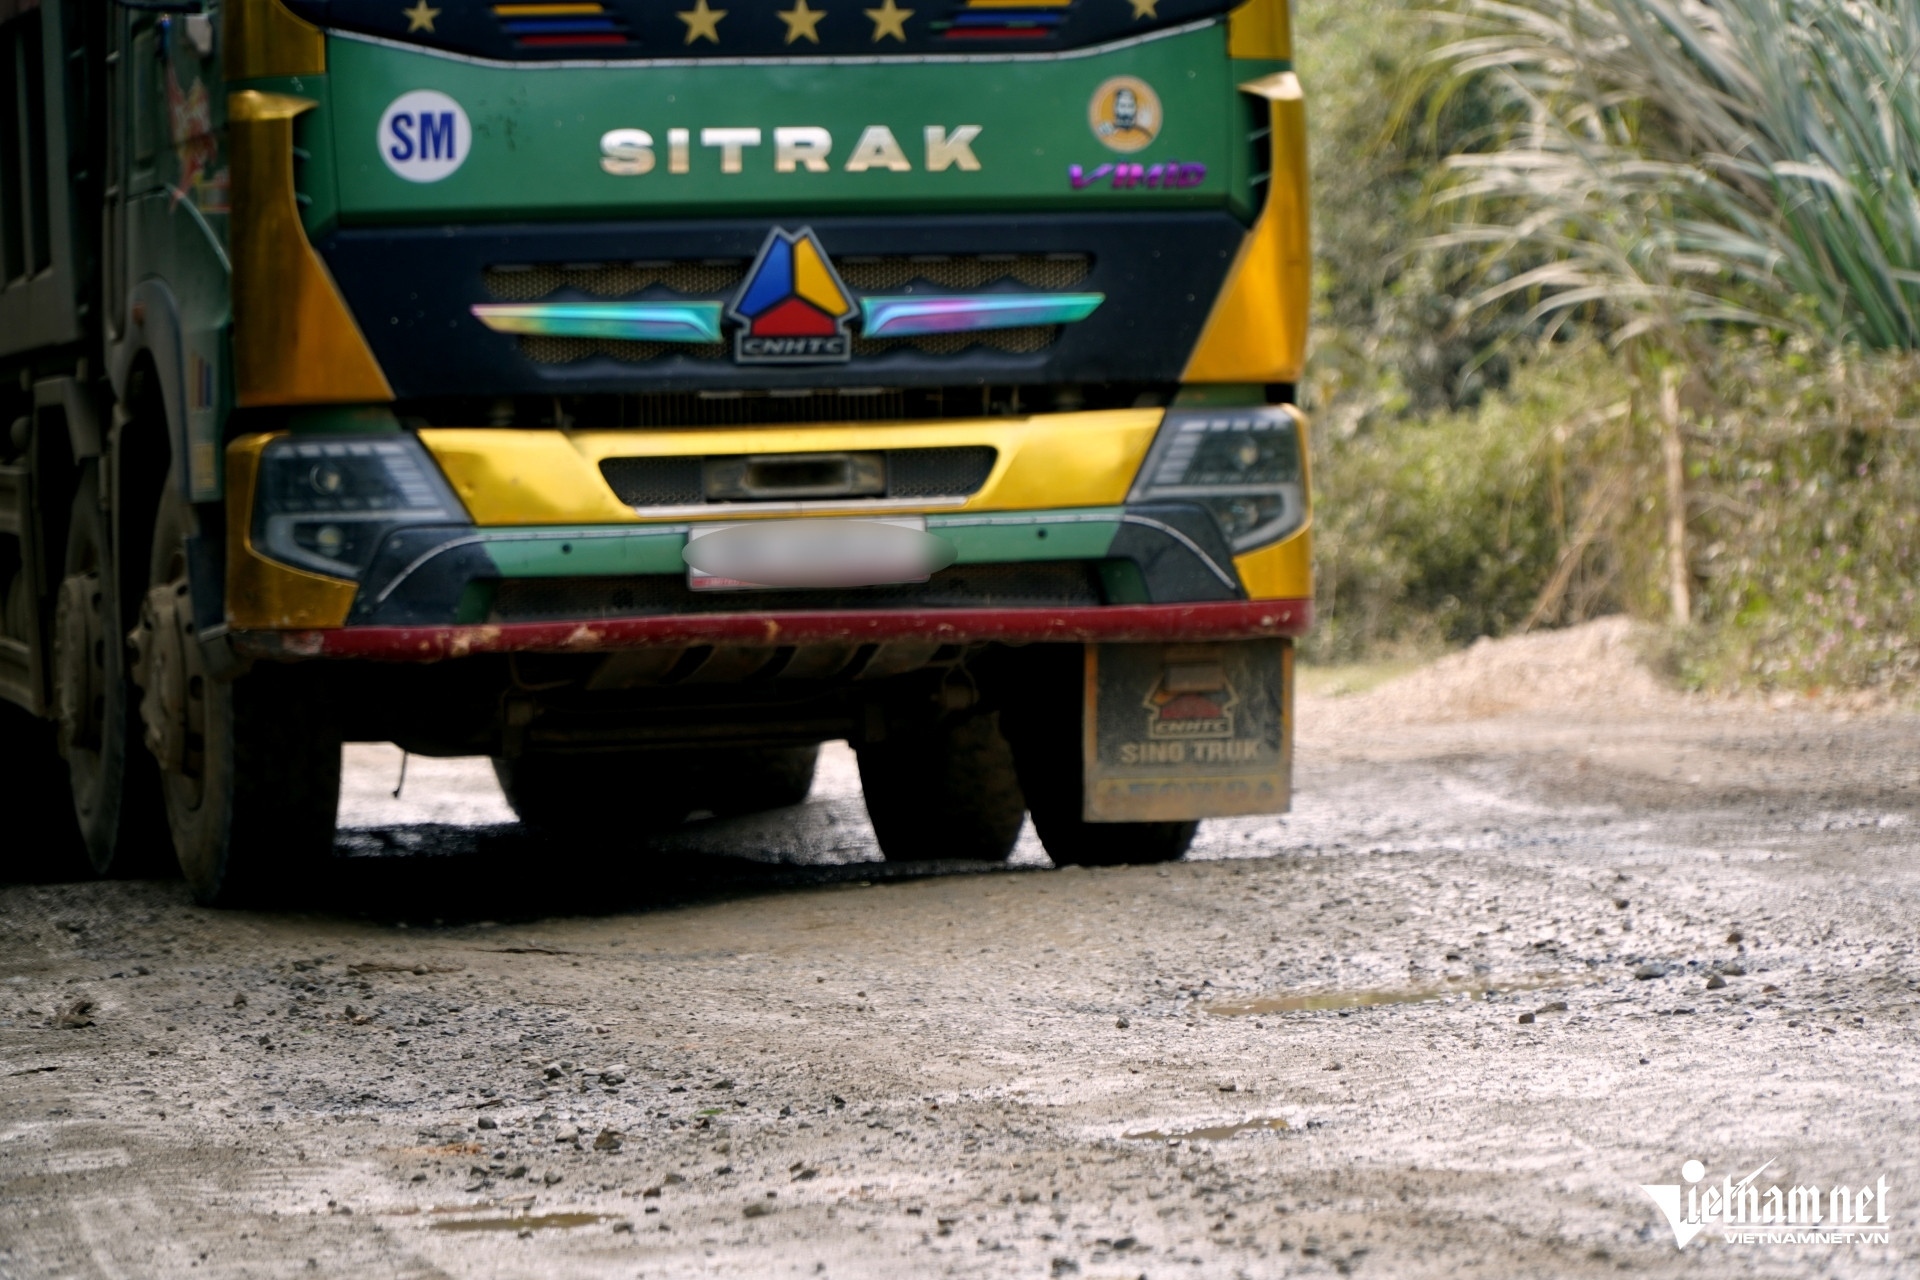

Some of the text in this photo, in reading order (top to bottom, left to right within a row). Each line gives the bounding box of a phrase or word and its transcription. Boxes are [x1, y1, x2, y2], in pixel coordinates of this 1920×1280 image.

[390, 111, 457, 163] SM
[600, 125, 983, 176] SITRAK
[744, 337, 843, 355] CNHTC
[1120, 739, 1259, 764] SINO TRUK
